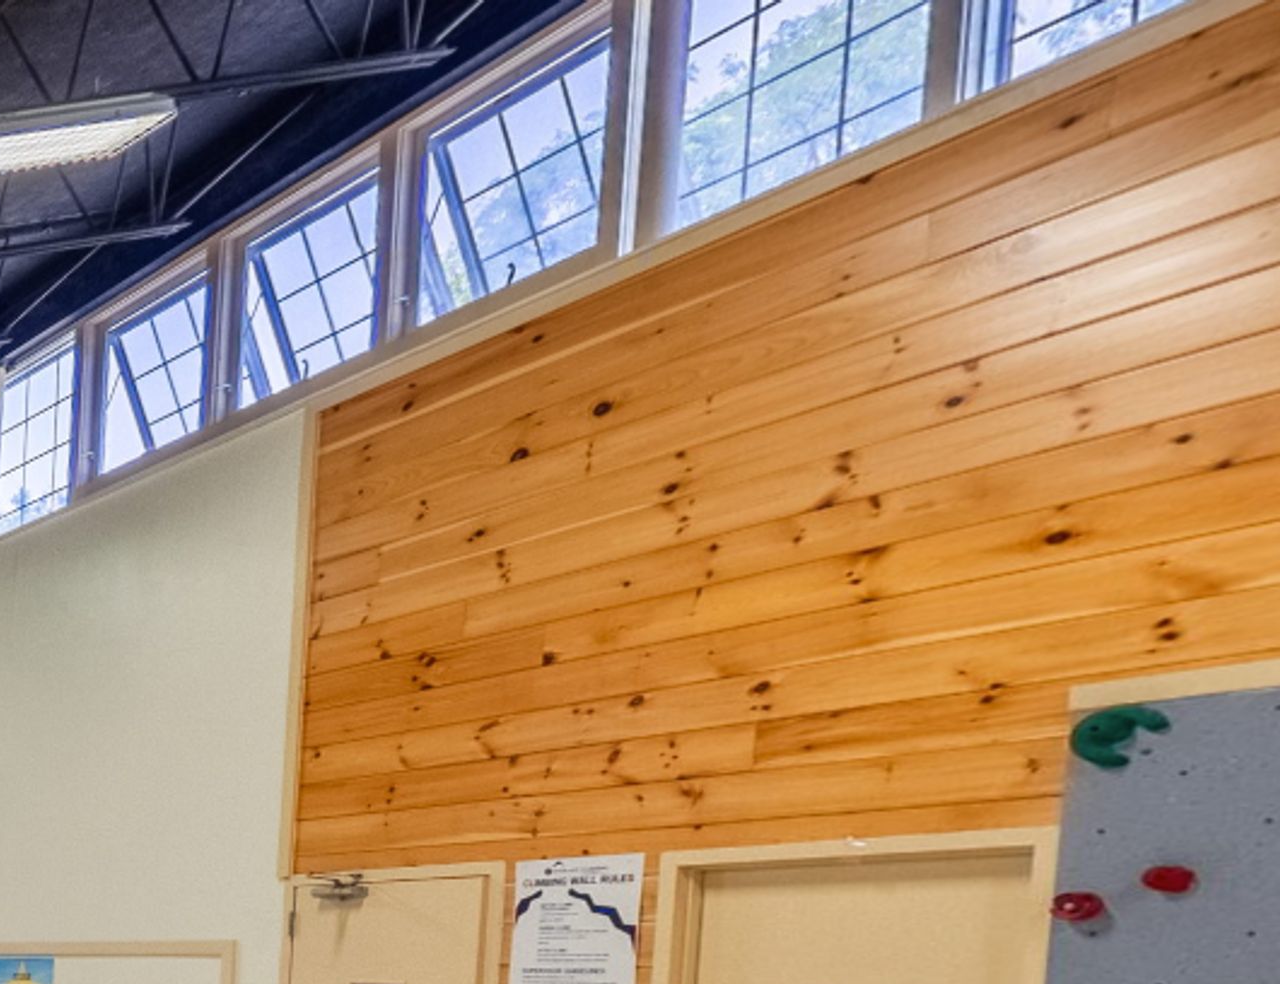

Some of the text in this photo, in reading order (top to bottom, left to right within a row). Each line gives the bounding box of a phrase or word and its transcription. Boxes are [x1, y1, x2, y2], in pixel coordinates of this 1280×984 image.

[522, 873, 635, 887] CLIMBING WALL RULES
